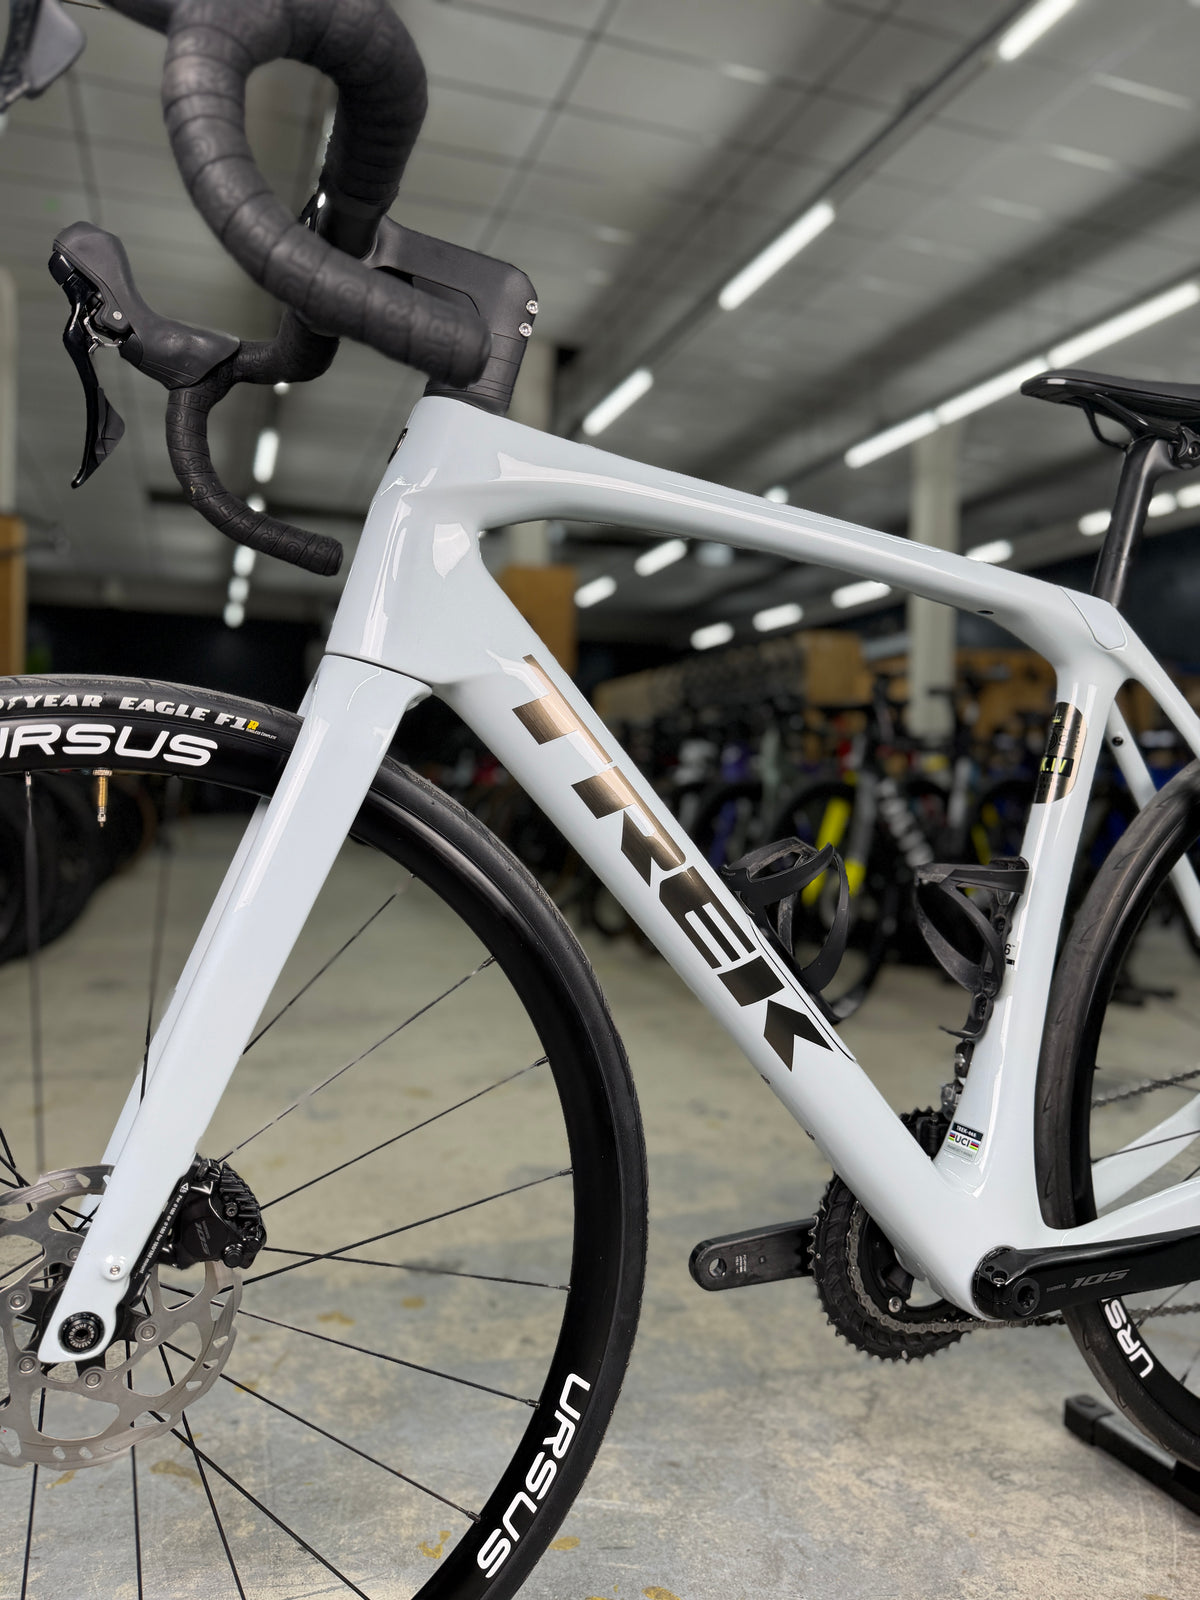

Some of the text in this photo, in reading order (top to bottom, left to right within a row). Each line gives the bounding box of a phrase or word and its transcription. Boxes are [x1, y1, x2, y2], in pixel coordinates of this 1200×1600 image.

[0, 694, 103, 711] YEAR
[118, 696, 211, 721] EAGLE
[512, 654, 834, 1072] TREK
[954, 1134, 971, 1148] UCI
[1070, 1268, 1131, 1290] 105
[1101, 1296, 1155, 1379] URS
[476, 1373, 591, 1579] URSUS
